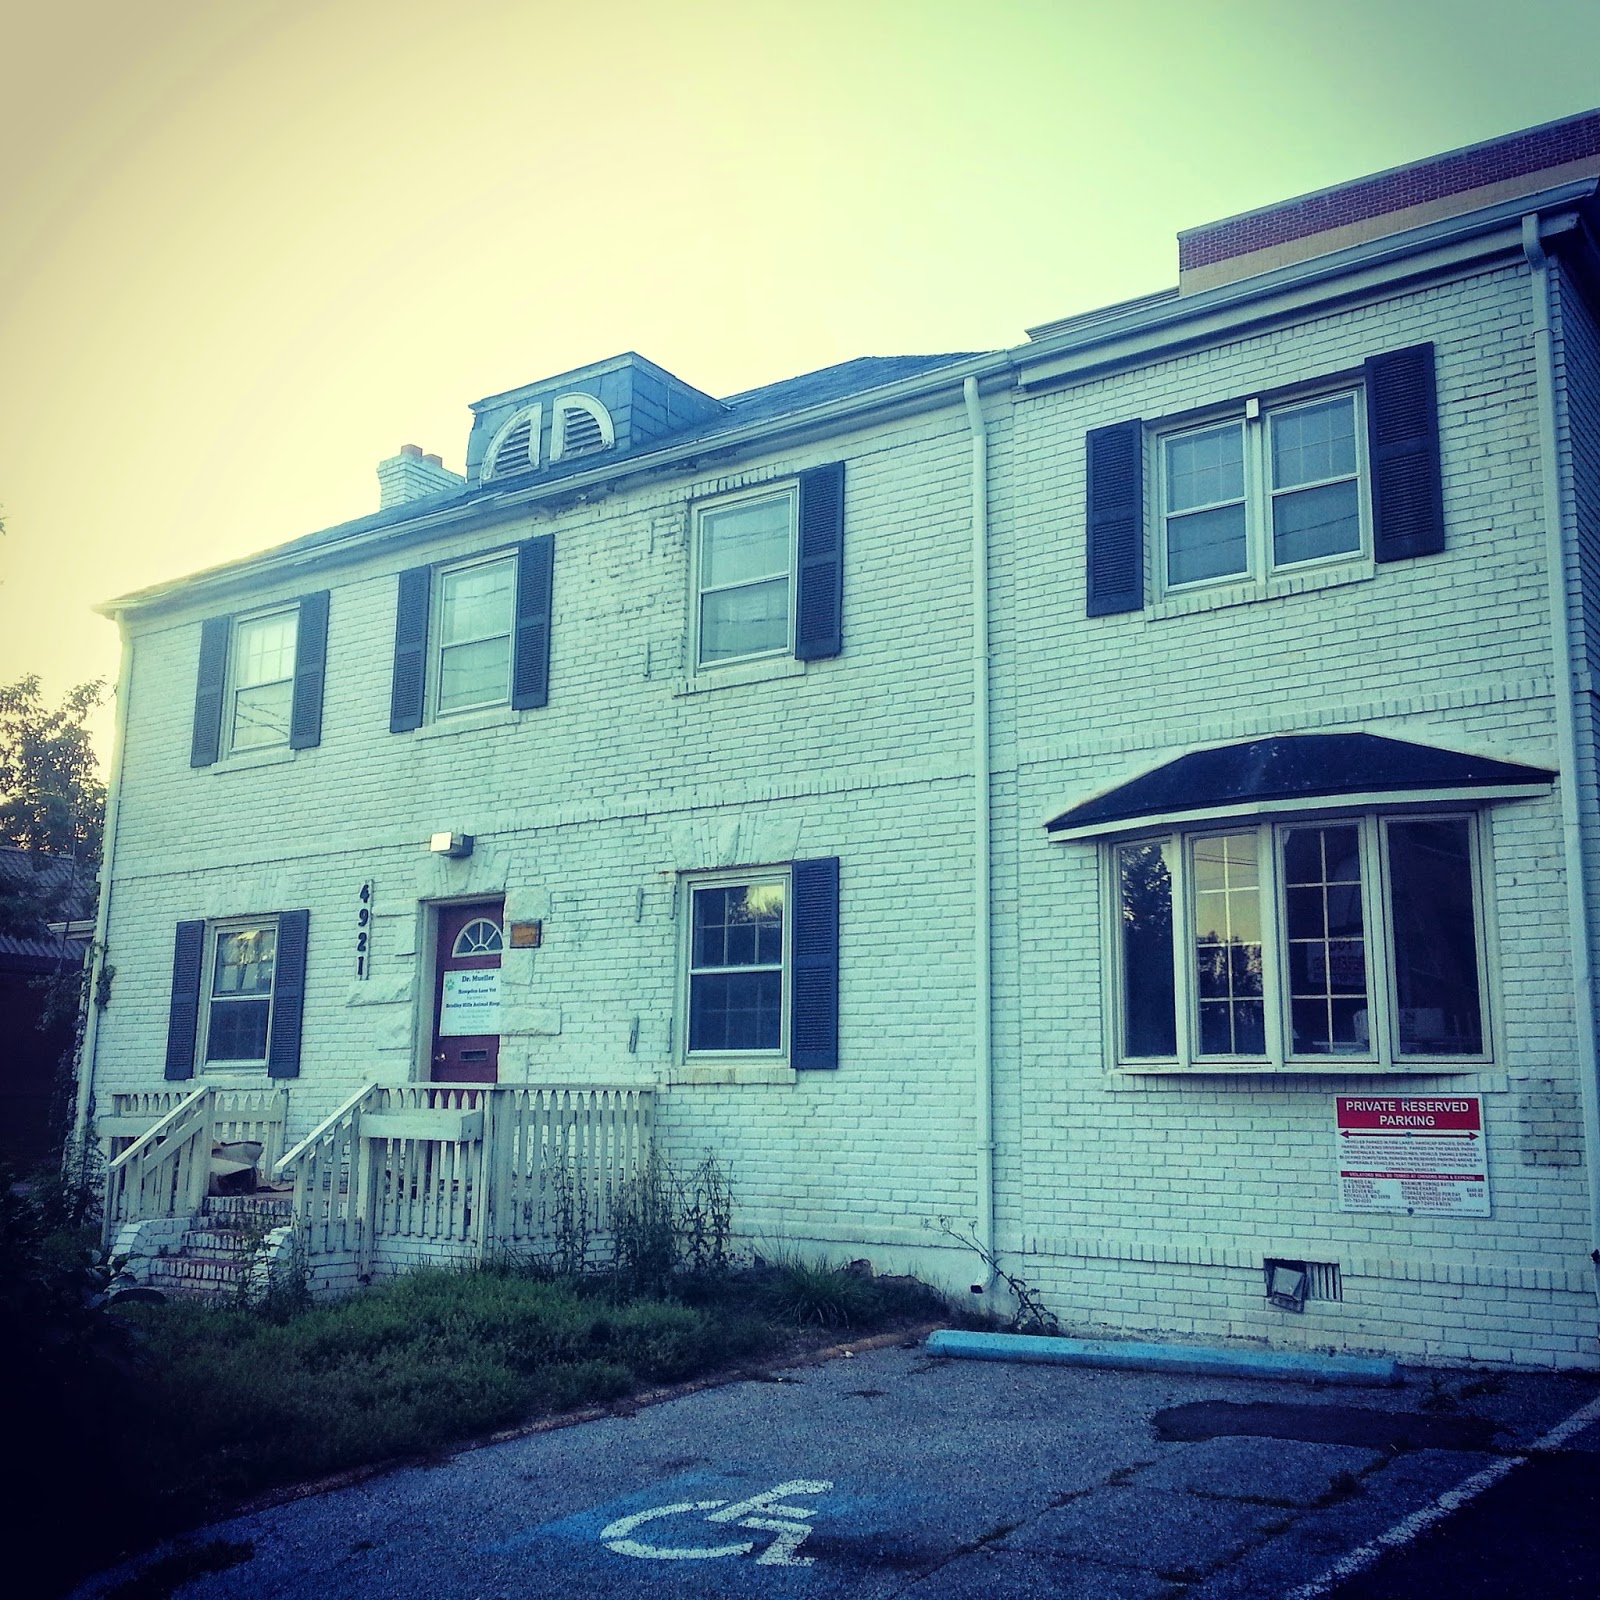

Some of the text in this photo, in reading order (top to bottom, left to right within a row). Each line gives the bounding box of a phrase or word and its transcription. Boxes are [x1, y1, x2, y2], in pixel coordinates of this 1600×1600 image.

[357, 885, 369, 975] 4921
[1346, 1101, 1469, 1112] PRIVATE RESERVED
[1380, 1115, 1435, 1126] PARKING
